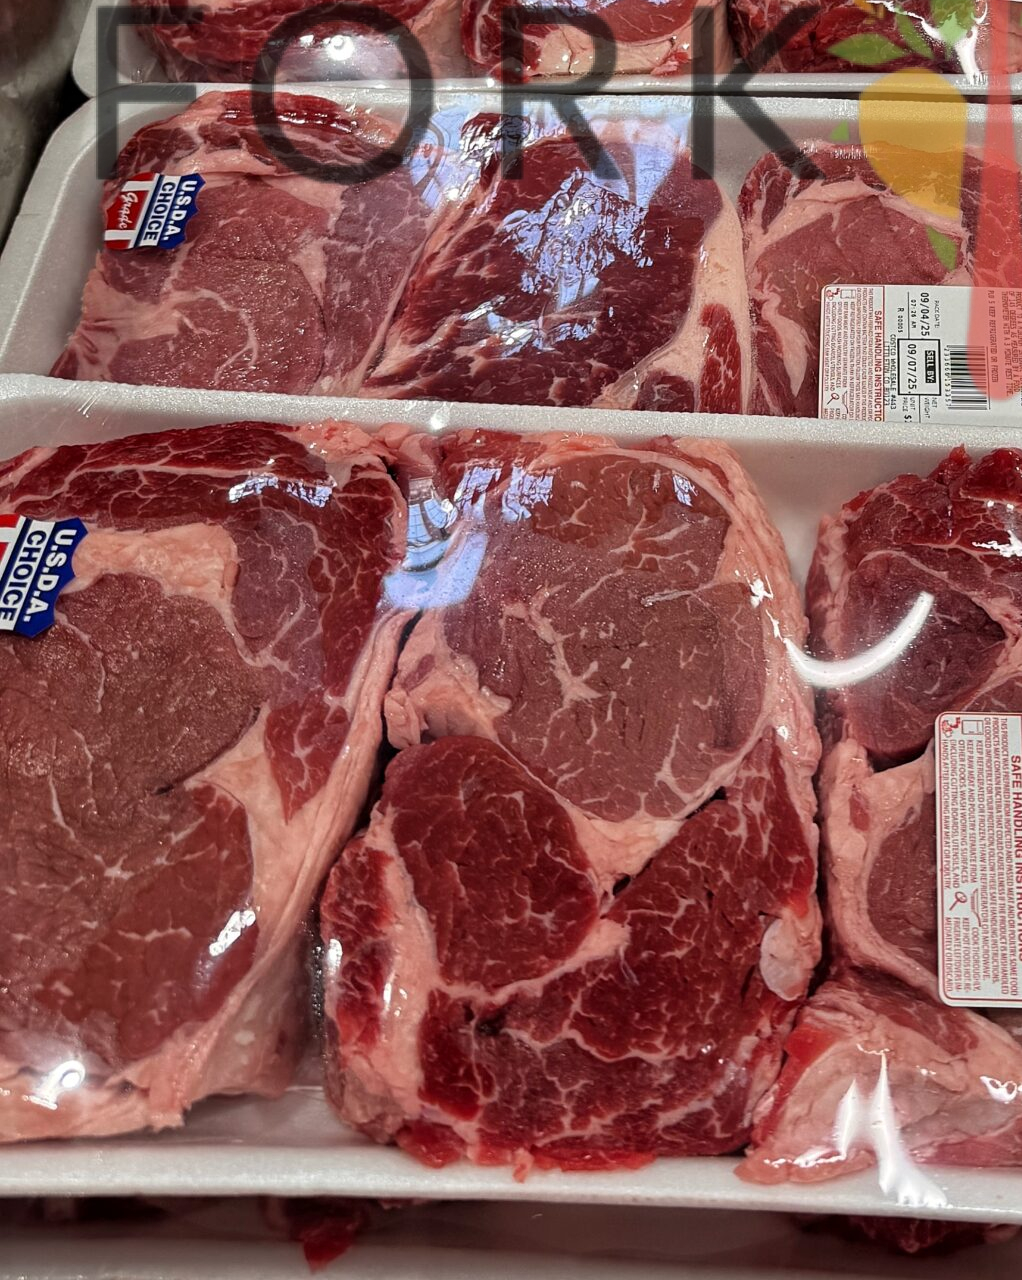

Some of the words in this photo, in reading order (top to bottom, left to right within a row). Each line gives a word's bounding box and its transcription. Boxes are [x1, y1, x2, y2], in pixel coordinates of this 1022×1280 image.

[119, 192, 139, 229] Grade
[143, 182, 176, 241] CHOICE
[163, 180, 198, 241] U.S.D.A.
[874, 310, 883, 331] SAFE
[919, 292, 930, 336] 09/04/25
[874, 332, 882, 372] HANDLING
[888, 333, 897, 356] COSTCO
[889, 358, 897, 391] WHOLESALE
[873, 373, 882, 422] INSTRUCTIO
[0, 530, 47, 622] CHOICE
[23, 529, 77, 623] U.S.D.A.
[1010, 755, 1022, 788] SAFE
